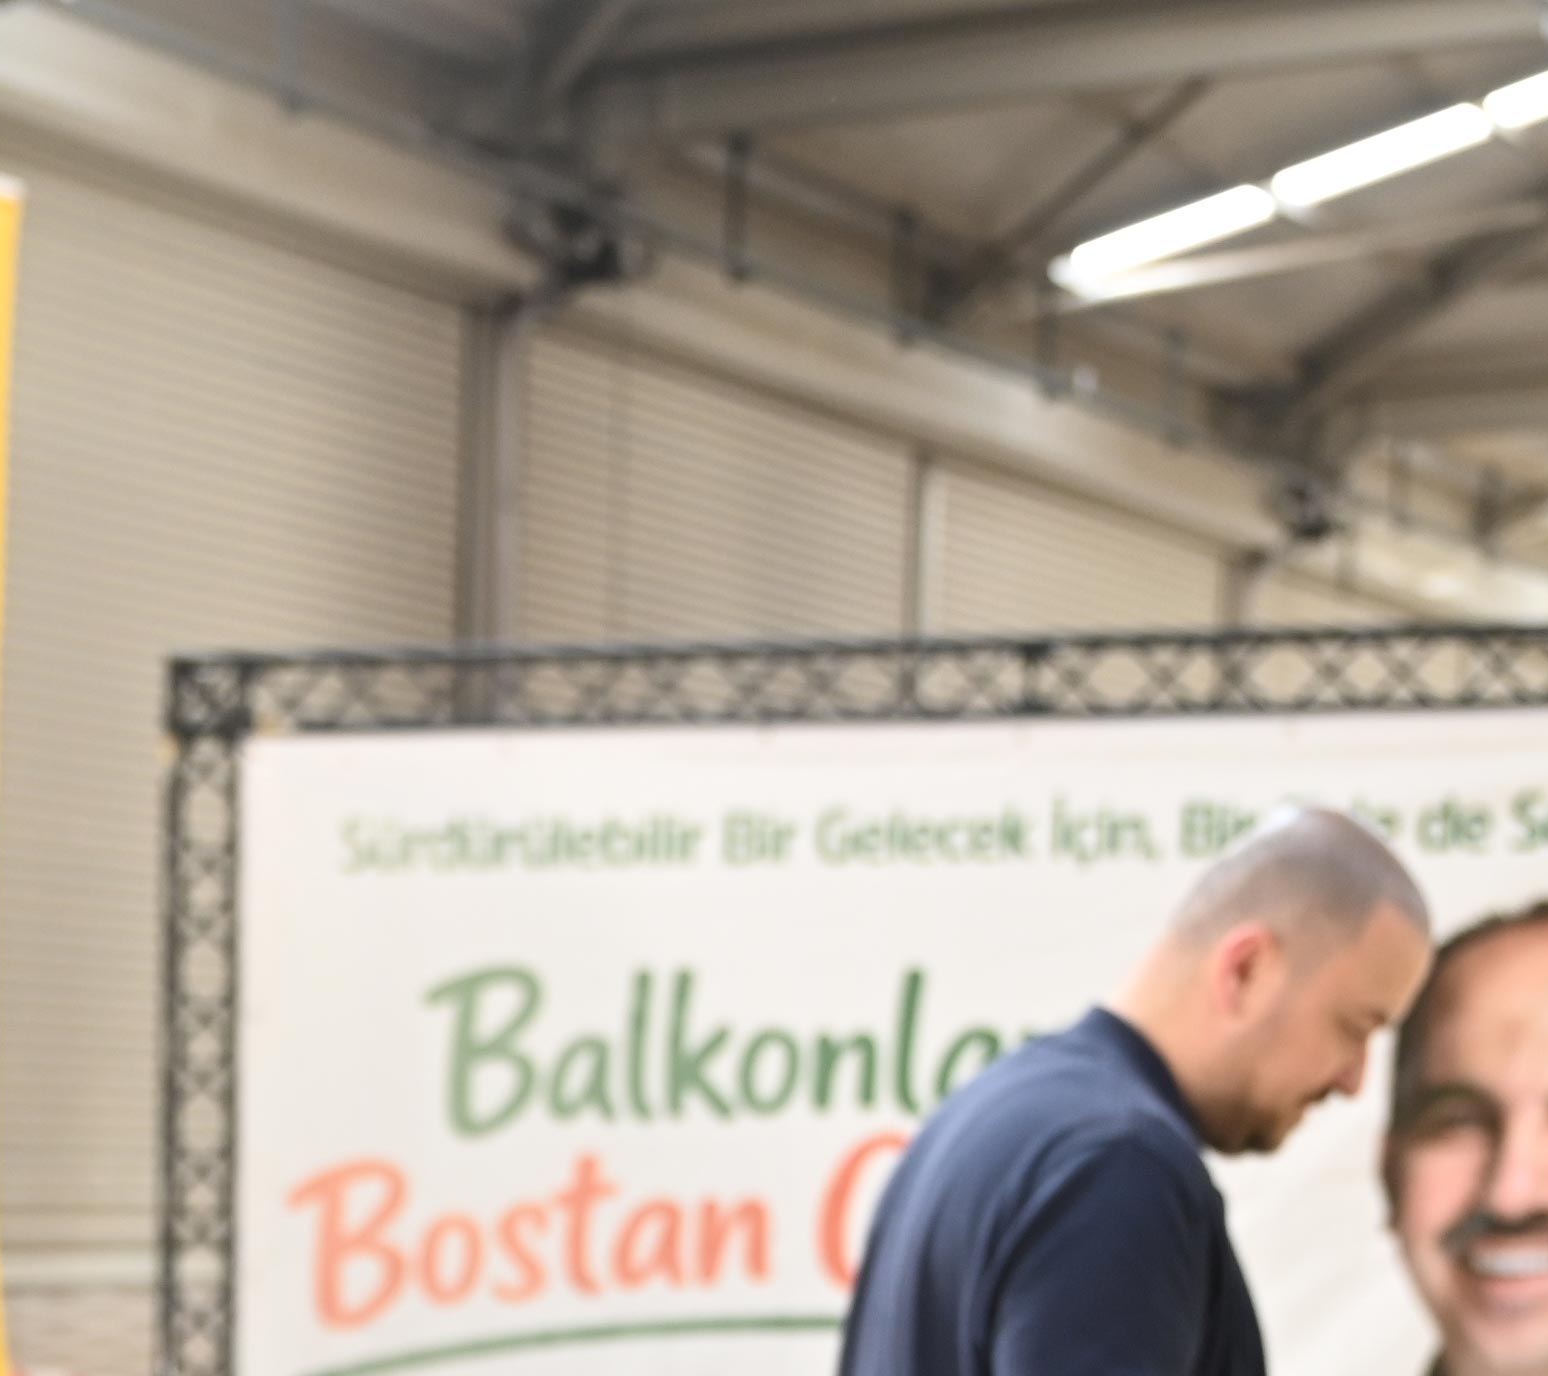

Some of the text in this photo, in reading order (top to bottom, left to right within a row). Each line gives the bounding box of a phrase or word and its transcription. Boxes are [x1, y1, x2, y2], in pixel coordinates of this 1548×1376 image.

[720, 810, 797, 867] Bir
[815, 803, 1029, 868] Gelecek
[286, 1152, 771, 1331] Bostan
